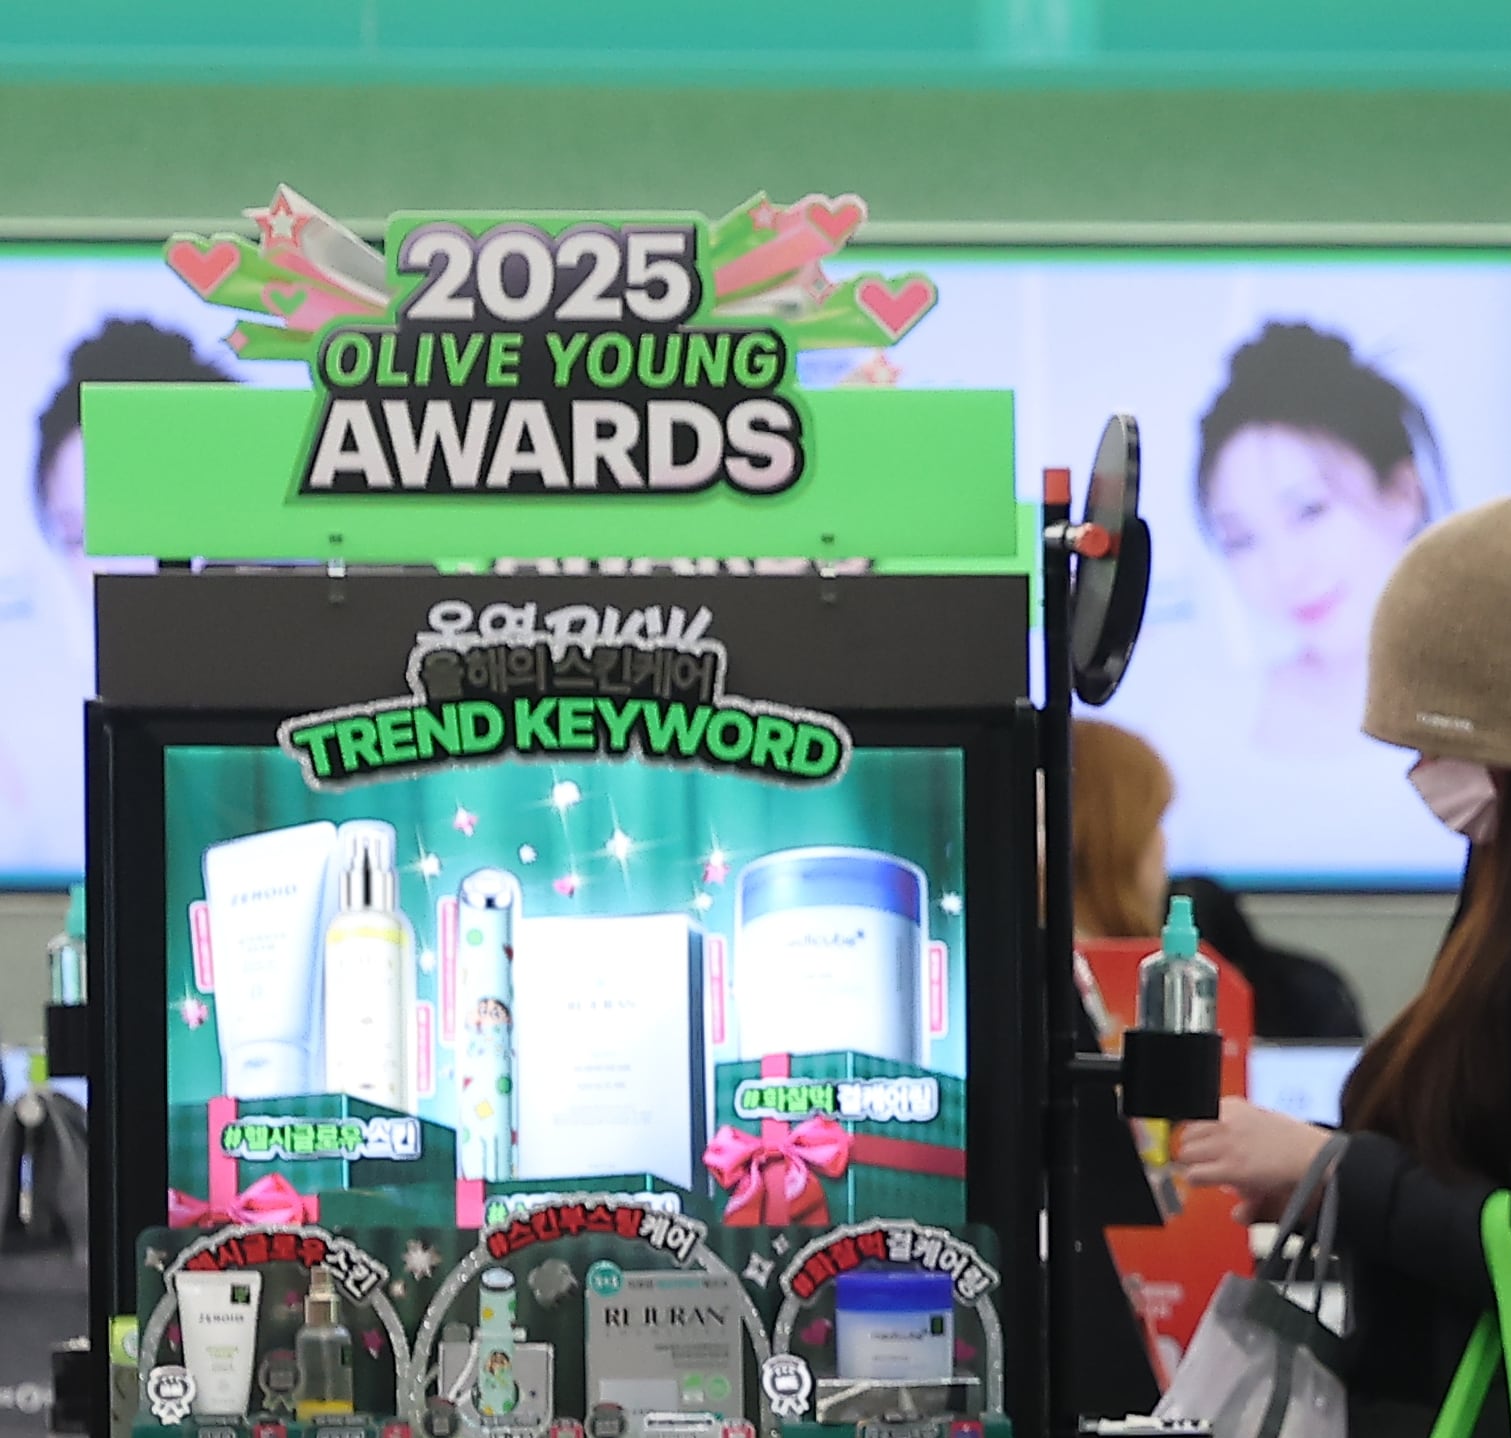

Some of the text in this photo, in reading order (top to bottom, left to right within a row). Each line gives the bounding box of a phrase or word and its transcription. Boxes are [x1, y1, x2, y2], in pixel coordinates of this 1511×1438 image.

[402, 224, 694, 324] 2025
[324, 331, 780, 390] OLIVE YOUNG
[309, 399, 800, 491] AWARDS
[294, 697, 841, 777] TREND KEYWORD
